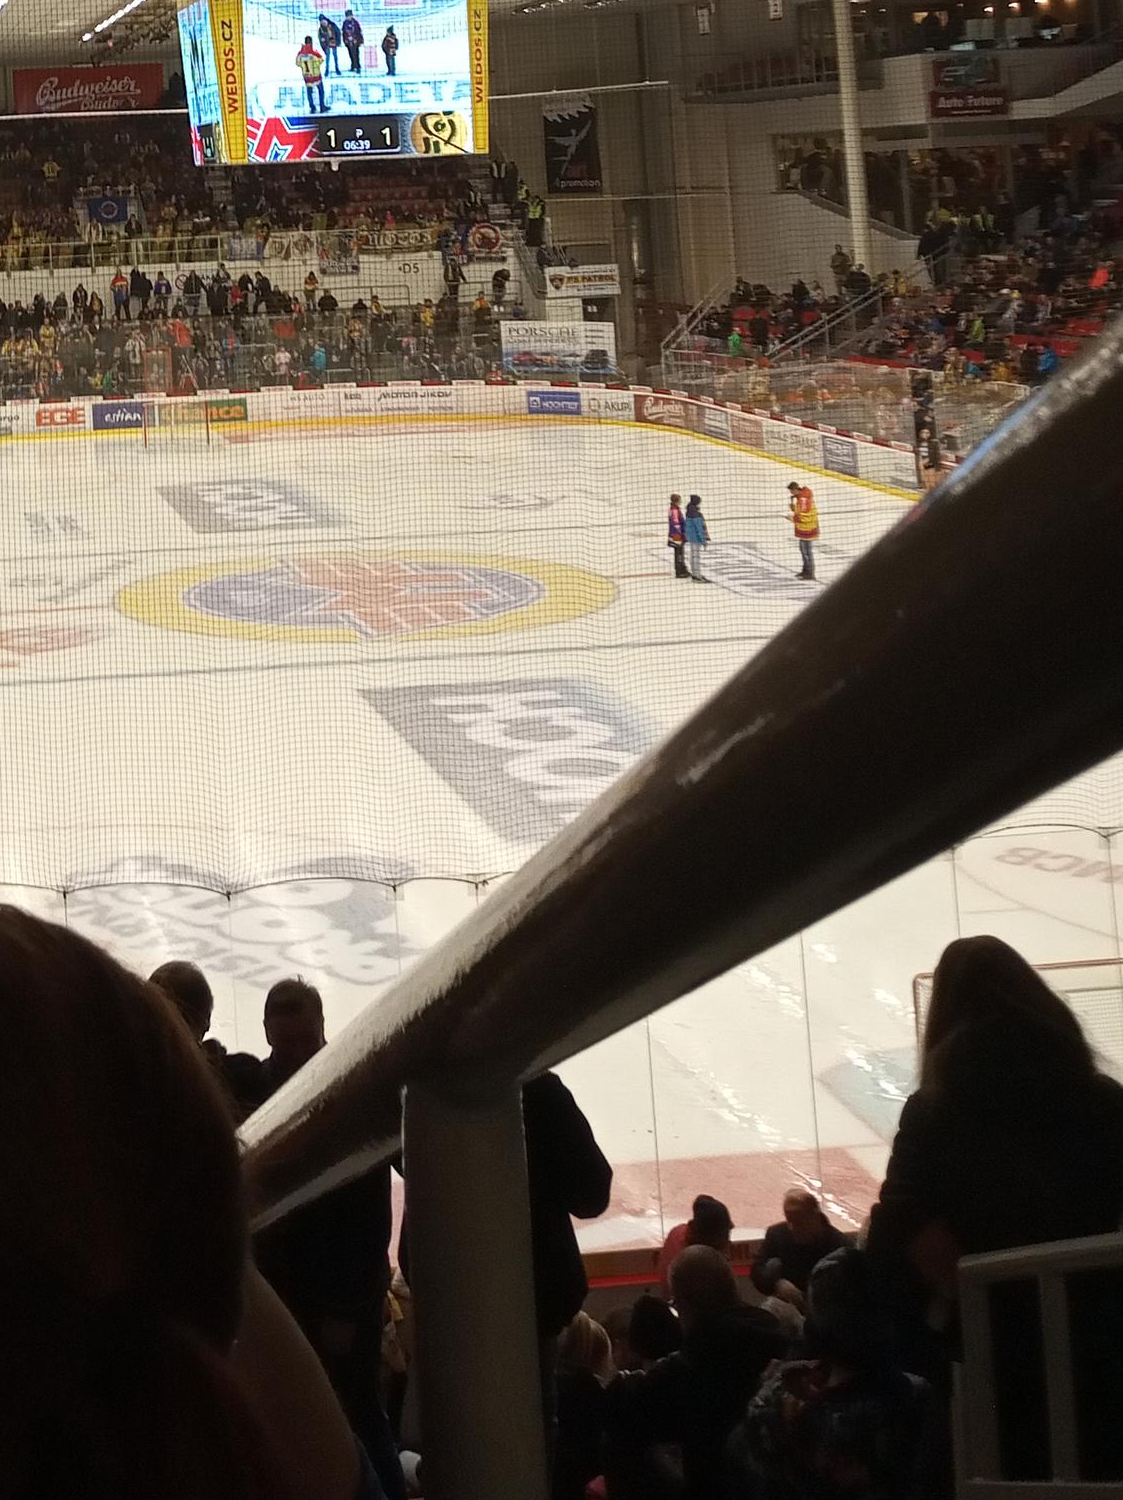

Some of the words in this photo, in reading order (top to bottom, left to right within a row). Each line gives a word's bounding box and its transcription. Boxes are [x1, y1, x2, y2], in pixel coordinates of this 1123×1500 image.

[221, 19, 239, 114] WEDOS.CZ
[36, 76, 141, 111] Budweiser
[327, 130, 336, 148] 1
[343, 139, 371, 150] 06:39
[381, 127, 391, 146] 1
